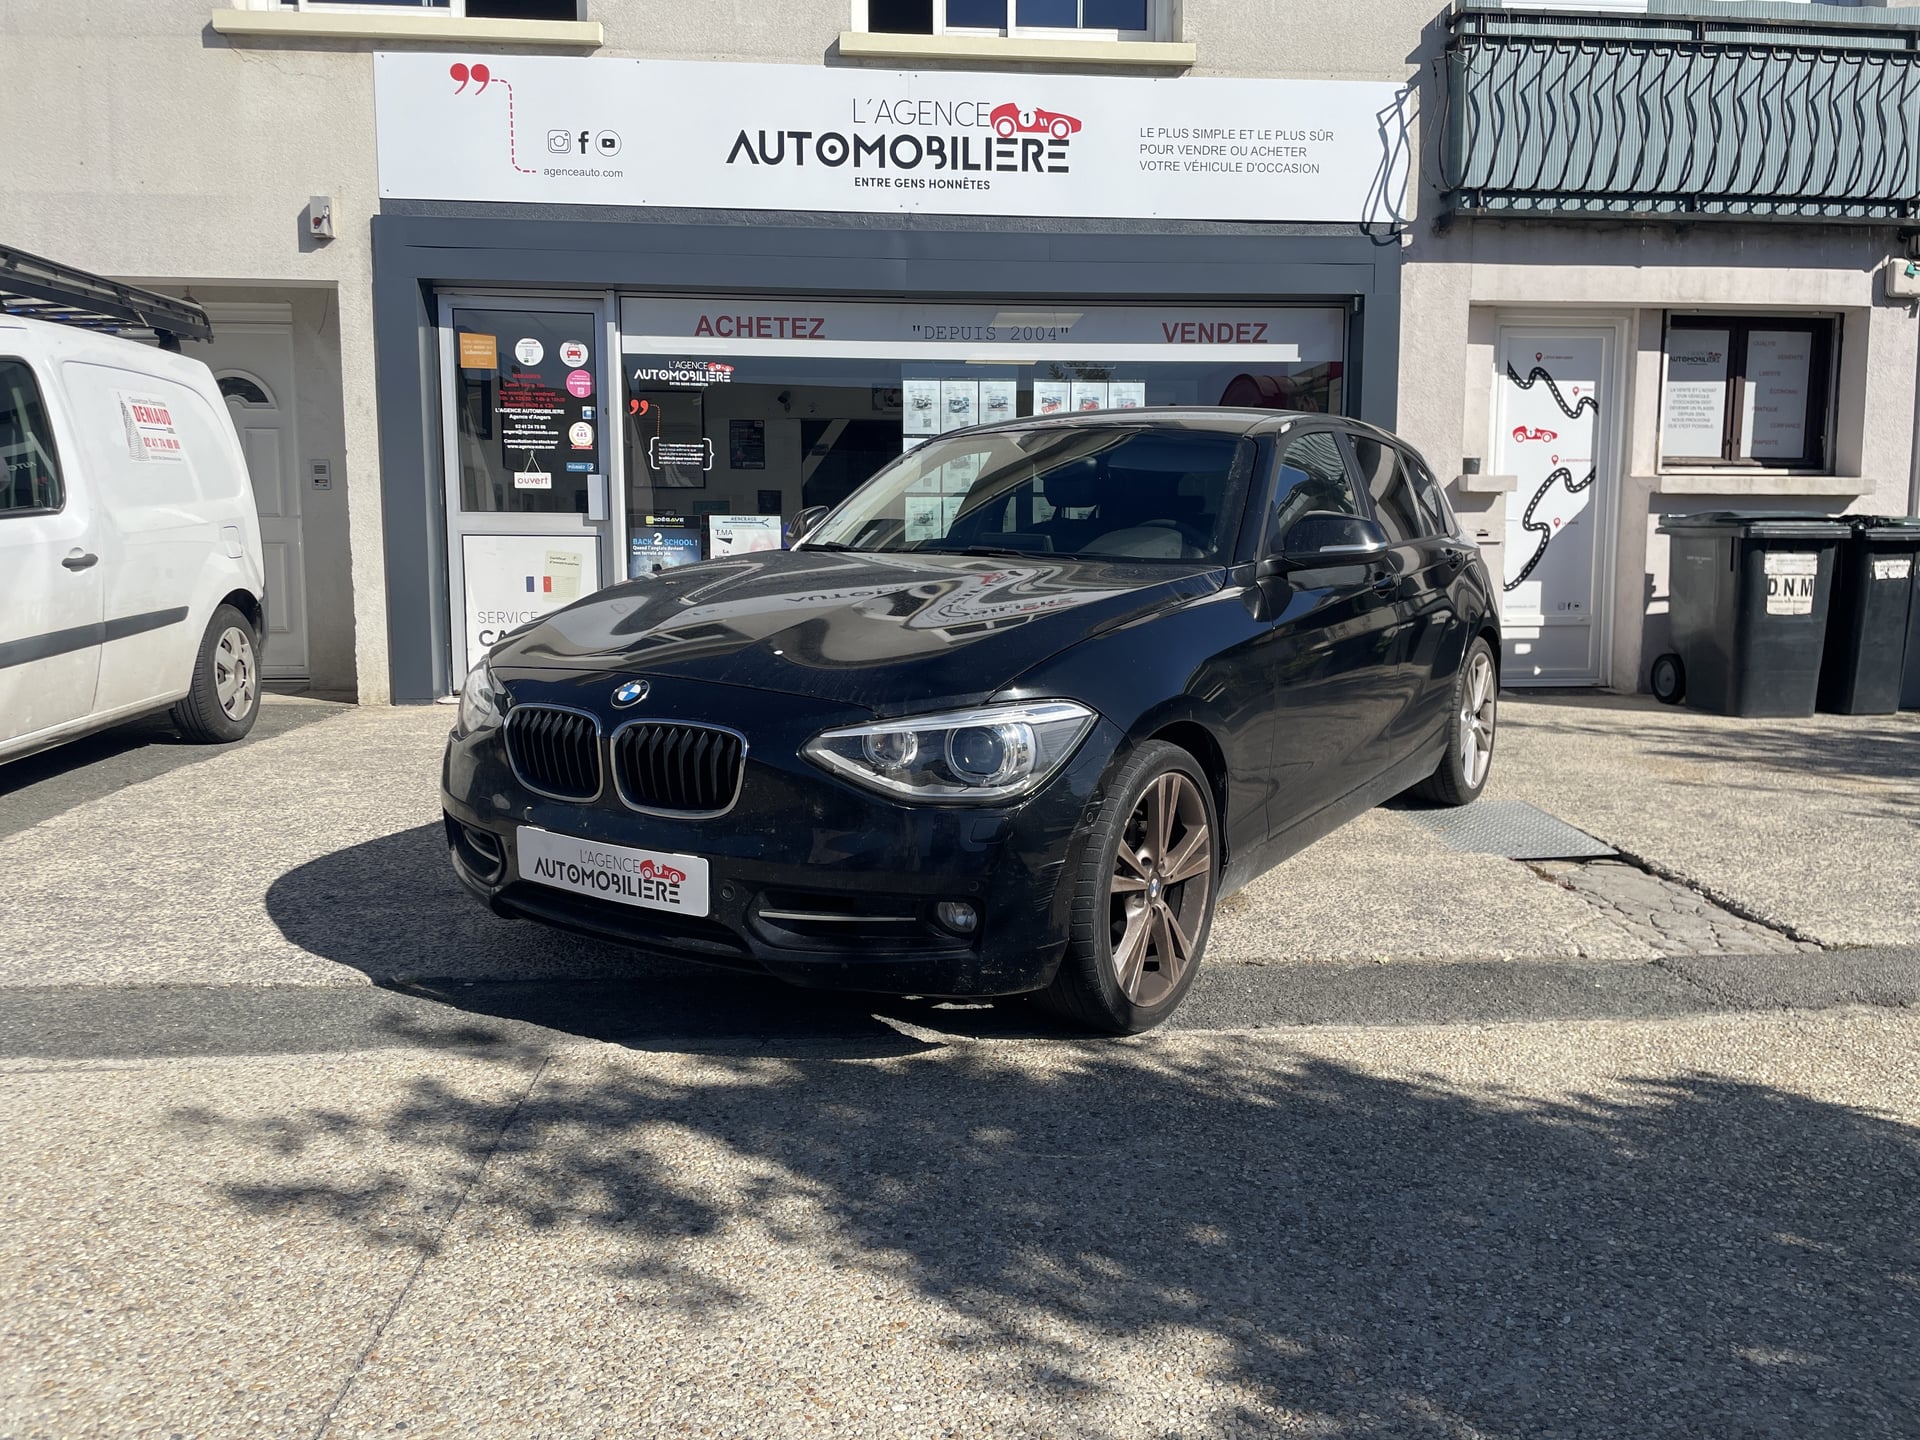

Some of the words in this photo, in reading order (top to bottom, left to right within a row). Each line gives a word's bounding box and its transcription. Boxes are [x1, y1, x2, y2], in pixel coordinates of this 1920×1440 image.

[853, 98, 990, 128] L'AGENCE
[1140, 127, 1155, 138] LE
[1158, 128, 1189, 139] PLUS
[1192, 128, 1236, 140] SIMPLE
[1240, 129, 1254, 140] ET
[1258, 130, 1272, 140] LE
[1276, 130, 1306, 142] PLUS
[1309, 129, 1334, 141] SÛR
[1139, 144, 1174, 155] POUR
[1177, 145, 1227, 156] VENDRE
[1230, 146, 1248, 156] OU
[1250, 146, 1307, 157] ACHETER
[543, 168, 624, 178] agenceauto.com
[1139, 160, 1180, 171] VOTRE
[1184, 159, 1243, 172] VÉHICULE
[1246, 162, 1320, 174] D'OCCASION
[854, 176, 892, 189] ENTRE
[894, 178, 926, 190] GENS
[928, 177, 991, 191] HONNÊTES
[694, 315, 825, 339] ACHETEZ
[1161, 322, 1268, 344] VENDEZ
[668, 361, 709, 370] L'AGENCE
[132, 405, 172, 426] DENIAUD
[517, 477, 548, 485] ouvert
[653, 532, 663, 546] 2
[664, 538, 693, 546] SCHOOL
[580, 849, 641, 874] L'AGENCE
